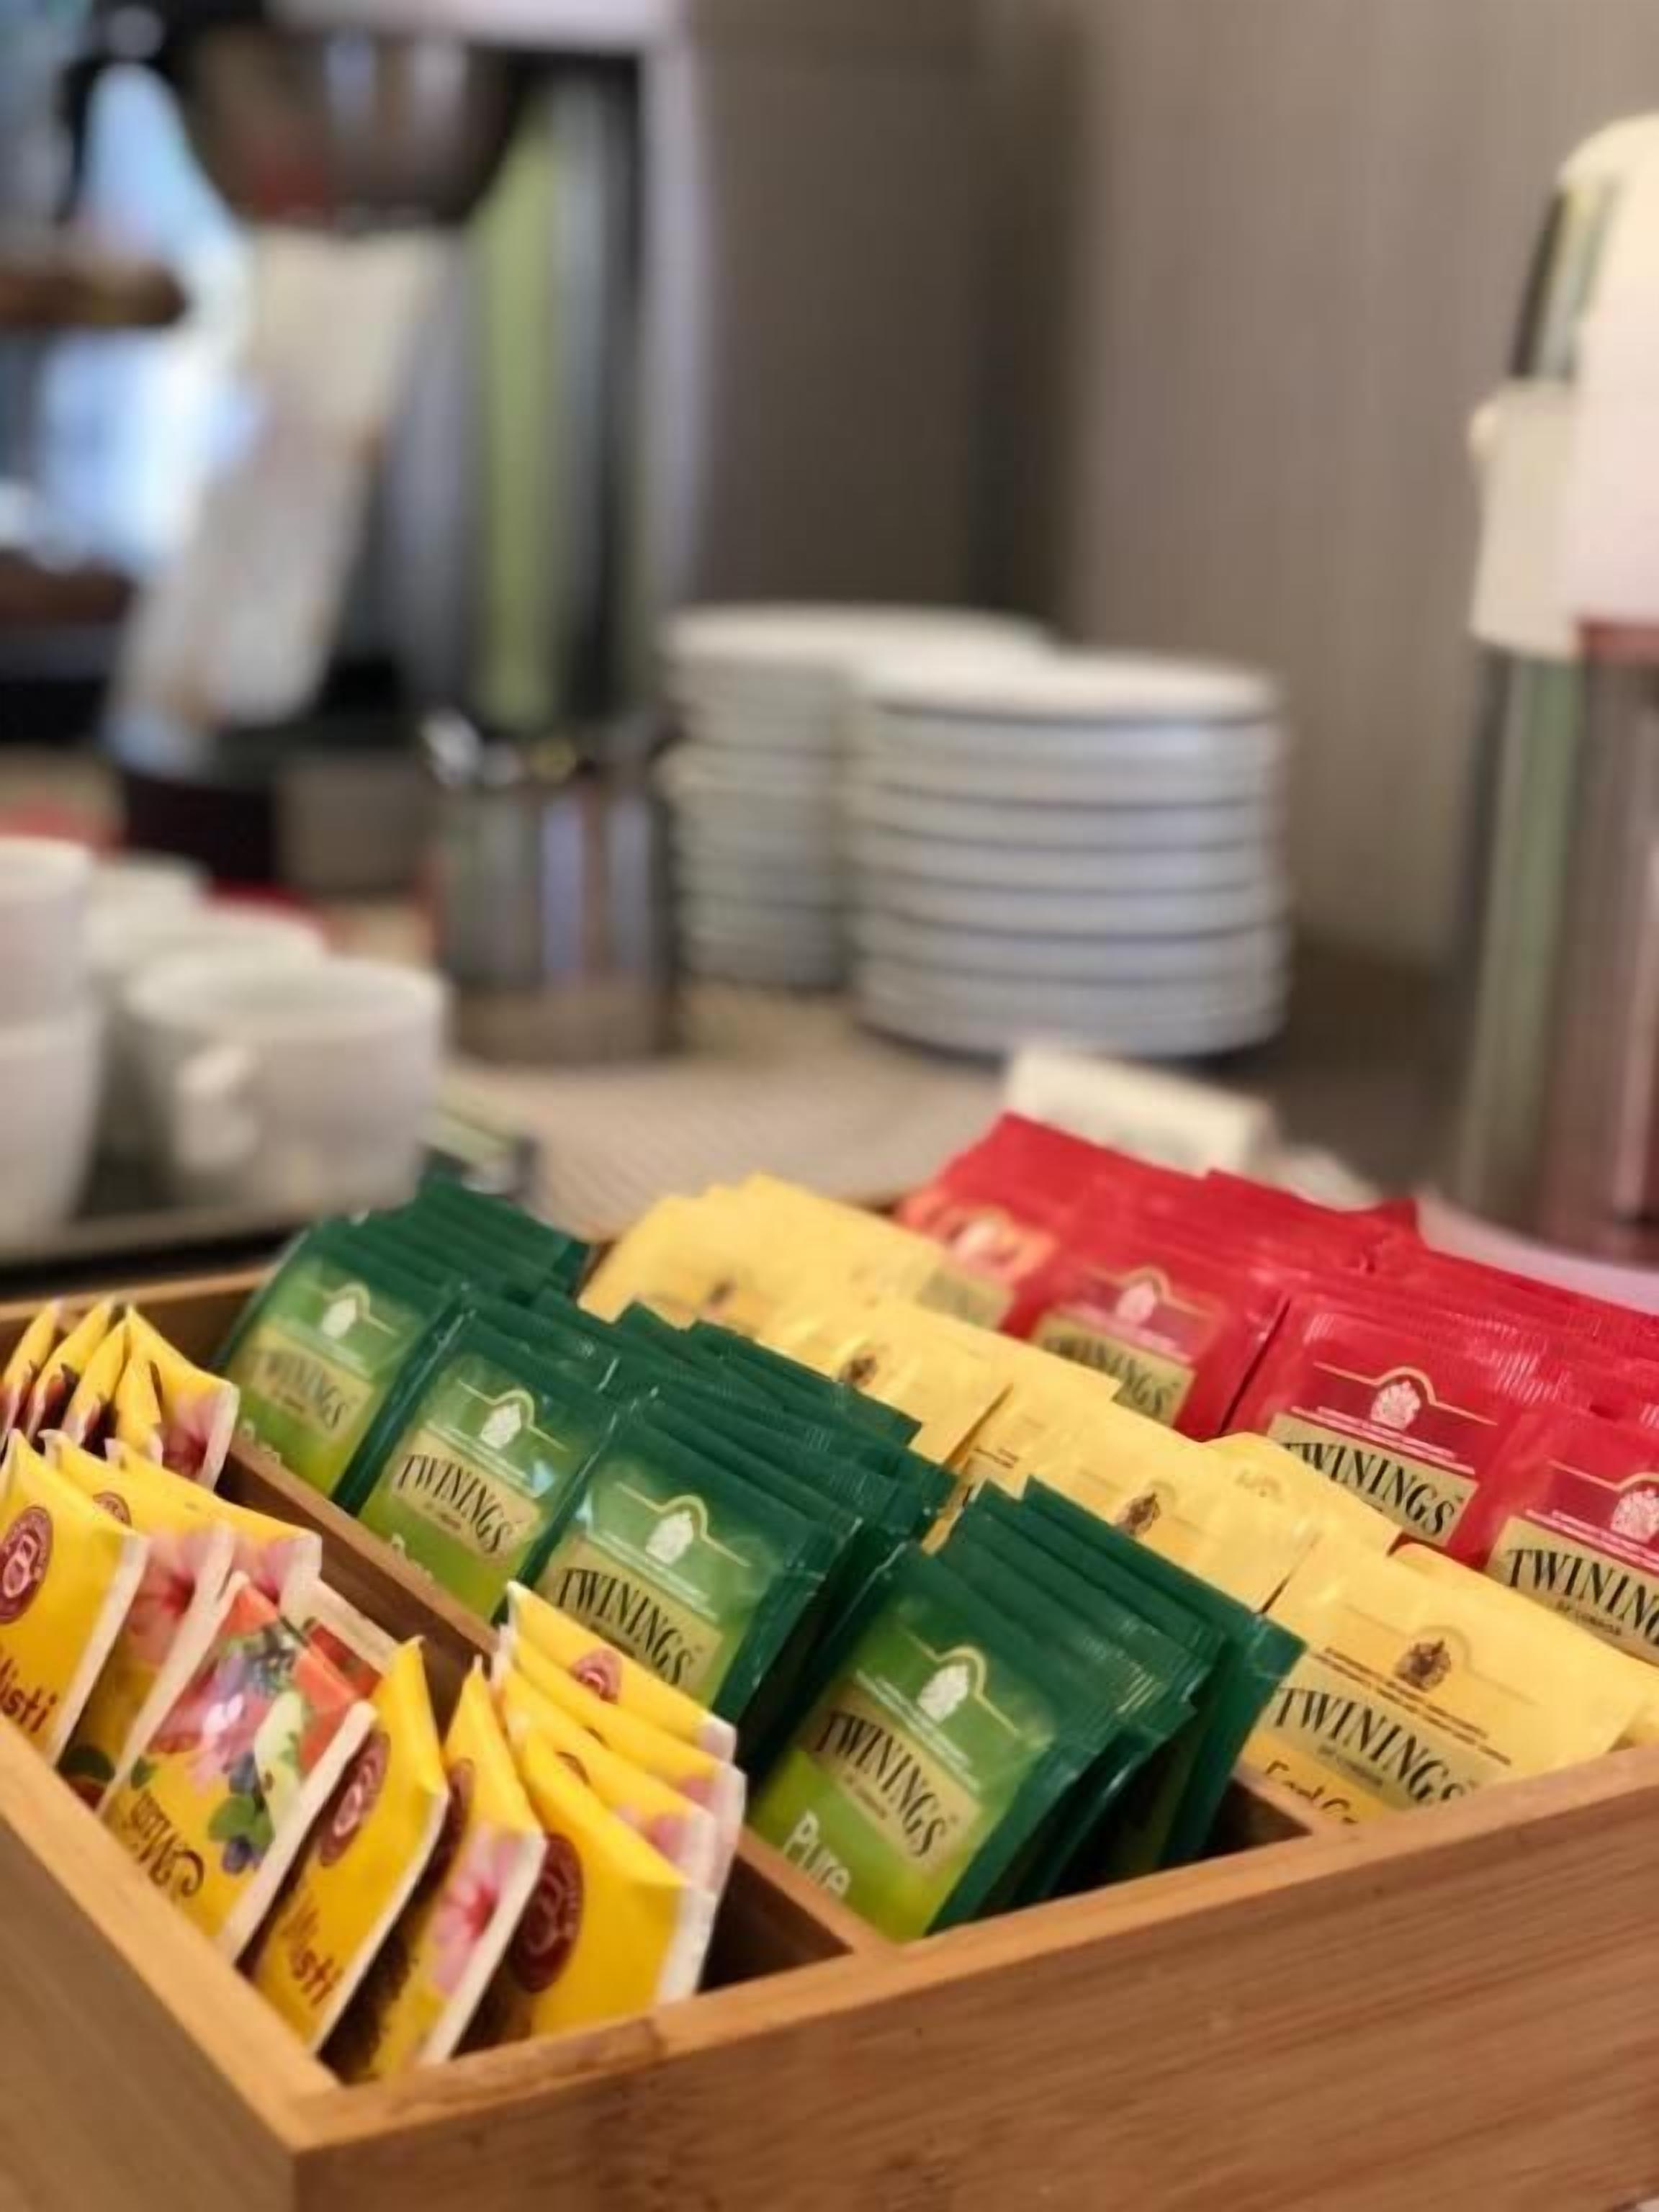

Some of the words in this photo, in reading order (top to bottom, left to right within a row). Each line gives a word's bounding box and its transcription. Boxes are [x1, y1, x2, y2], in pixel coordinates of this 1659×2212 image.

[398, 1453, 513, 1554] TWININGS
[558, 1567, 694, 1685] TWININGS
[0, 1647, 58, 1733] isti
[814, 1711, 945, 1858] TWININGS
[783, 1808, 852, 1897] Pure
